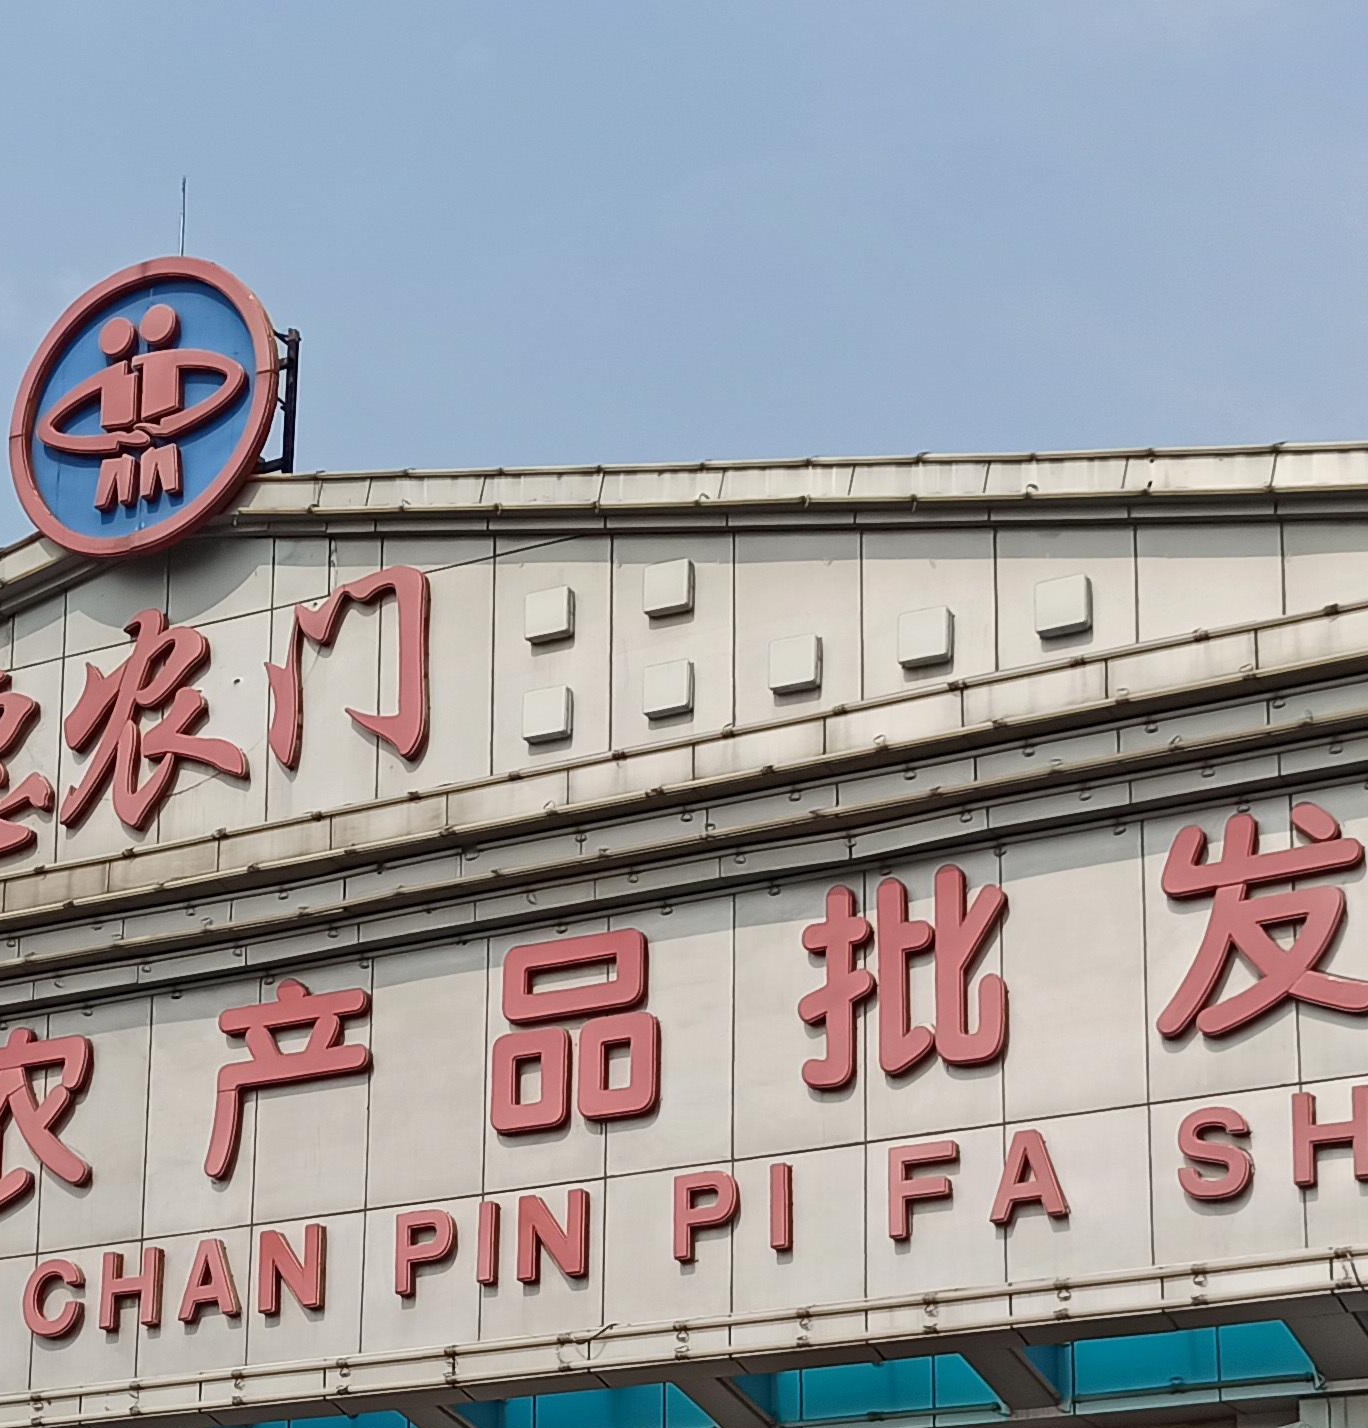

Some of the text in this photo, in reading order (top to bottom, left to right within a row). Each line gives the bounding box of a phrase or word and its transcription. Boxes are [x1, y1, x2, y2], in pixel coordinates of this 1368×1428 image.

[22, 1222, 327, 1339] CHAN
[393, 1187, 591, 1298] PIN
[672, 1162, 795, 1263] PI
[887, 1128, 1070, 1241] FA
